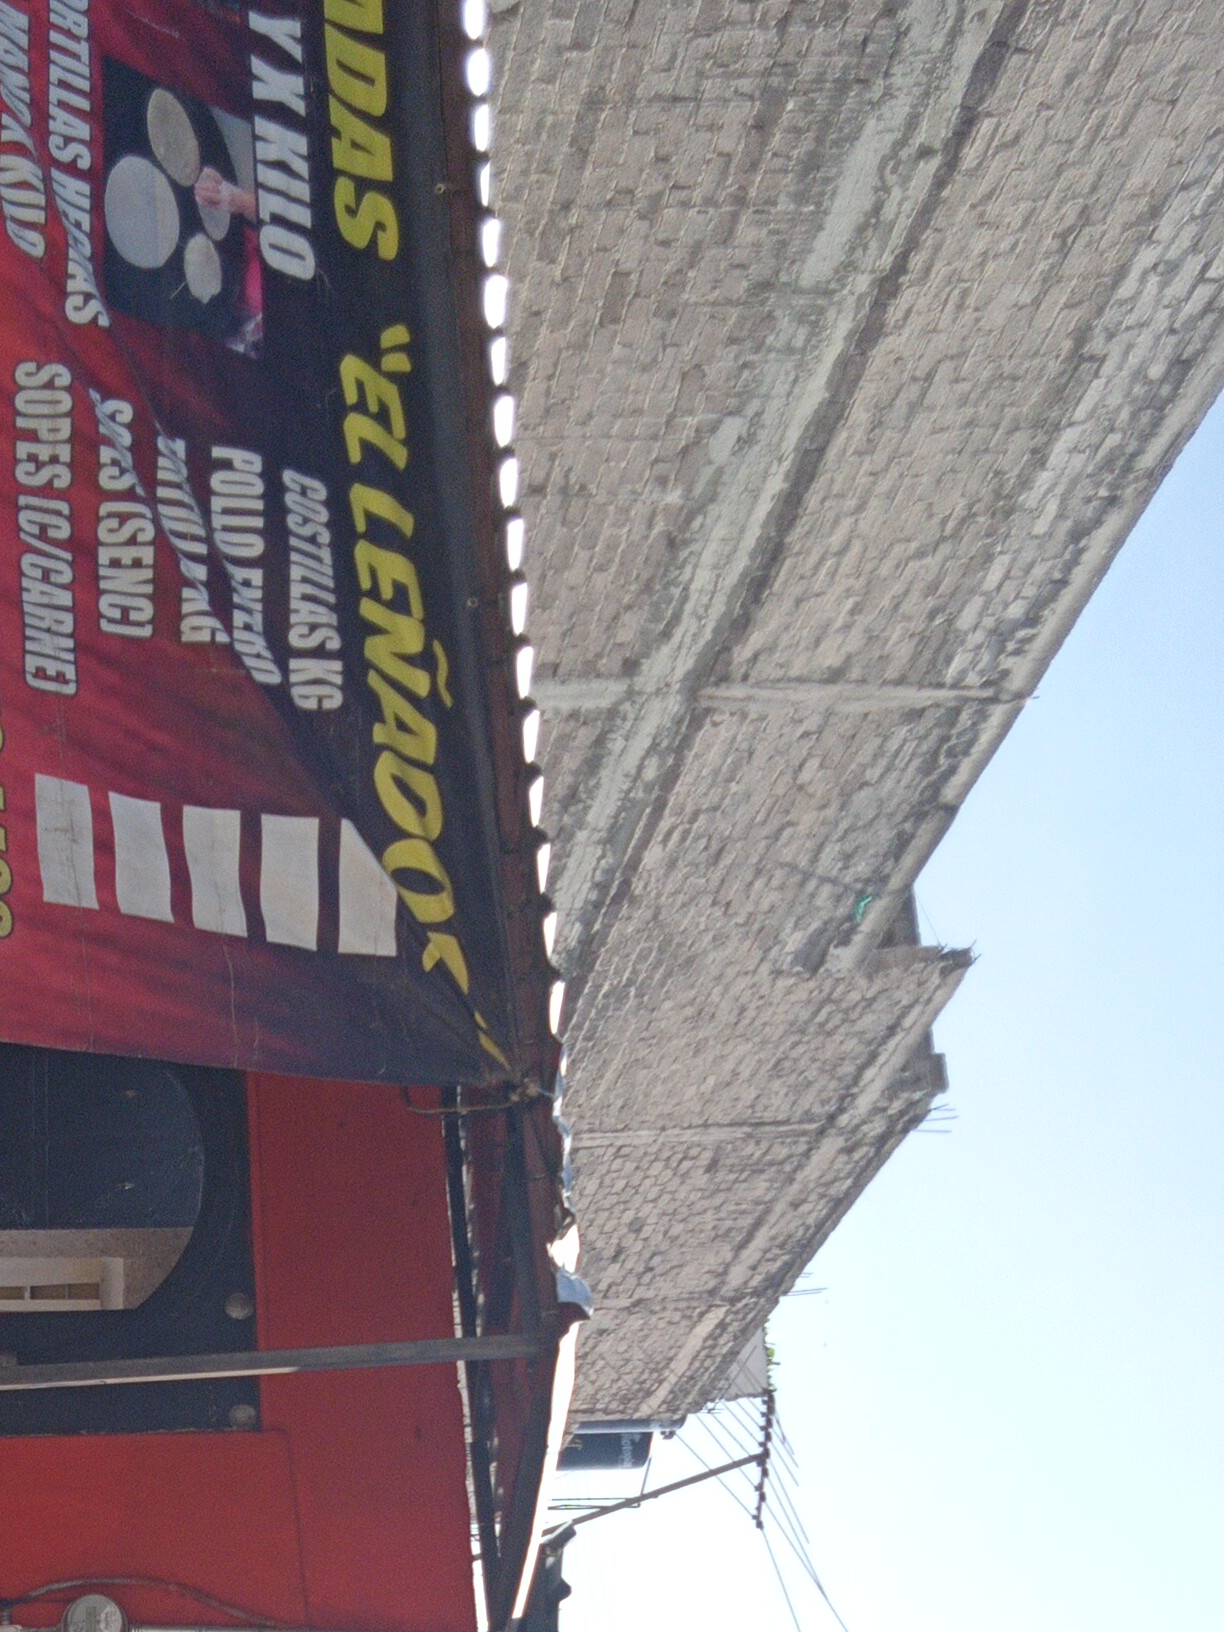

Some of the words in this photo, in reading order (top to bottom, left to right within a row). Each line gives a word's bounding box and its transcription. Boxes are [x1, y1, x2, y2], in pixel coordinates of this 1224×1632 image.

[248, 10, 303, 63] Y
[250, 54, 306, 117] X
[254, 115, 316, 281] KILO
[14, 361, 73, 490] SOPES
[210, 446, 265, 558] POLLO
[282, 468, 342, 650] COSTILLAS
[17, 494, 76, 697] (C/CARNE)
[288, 658, 344, 711] KG
